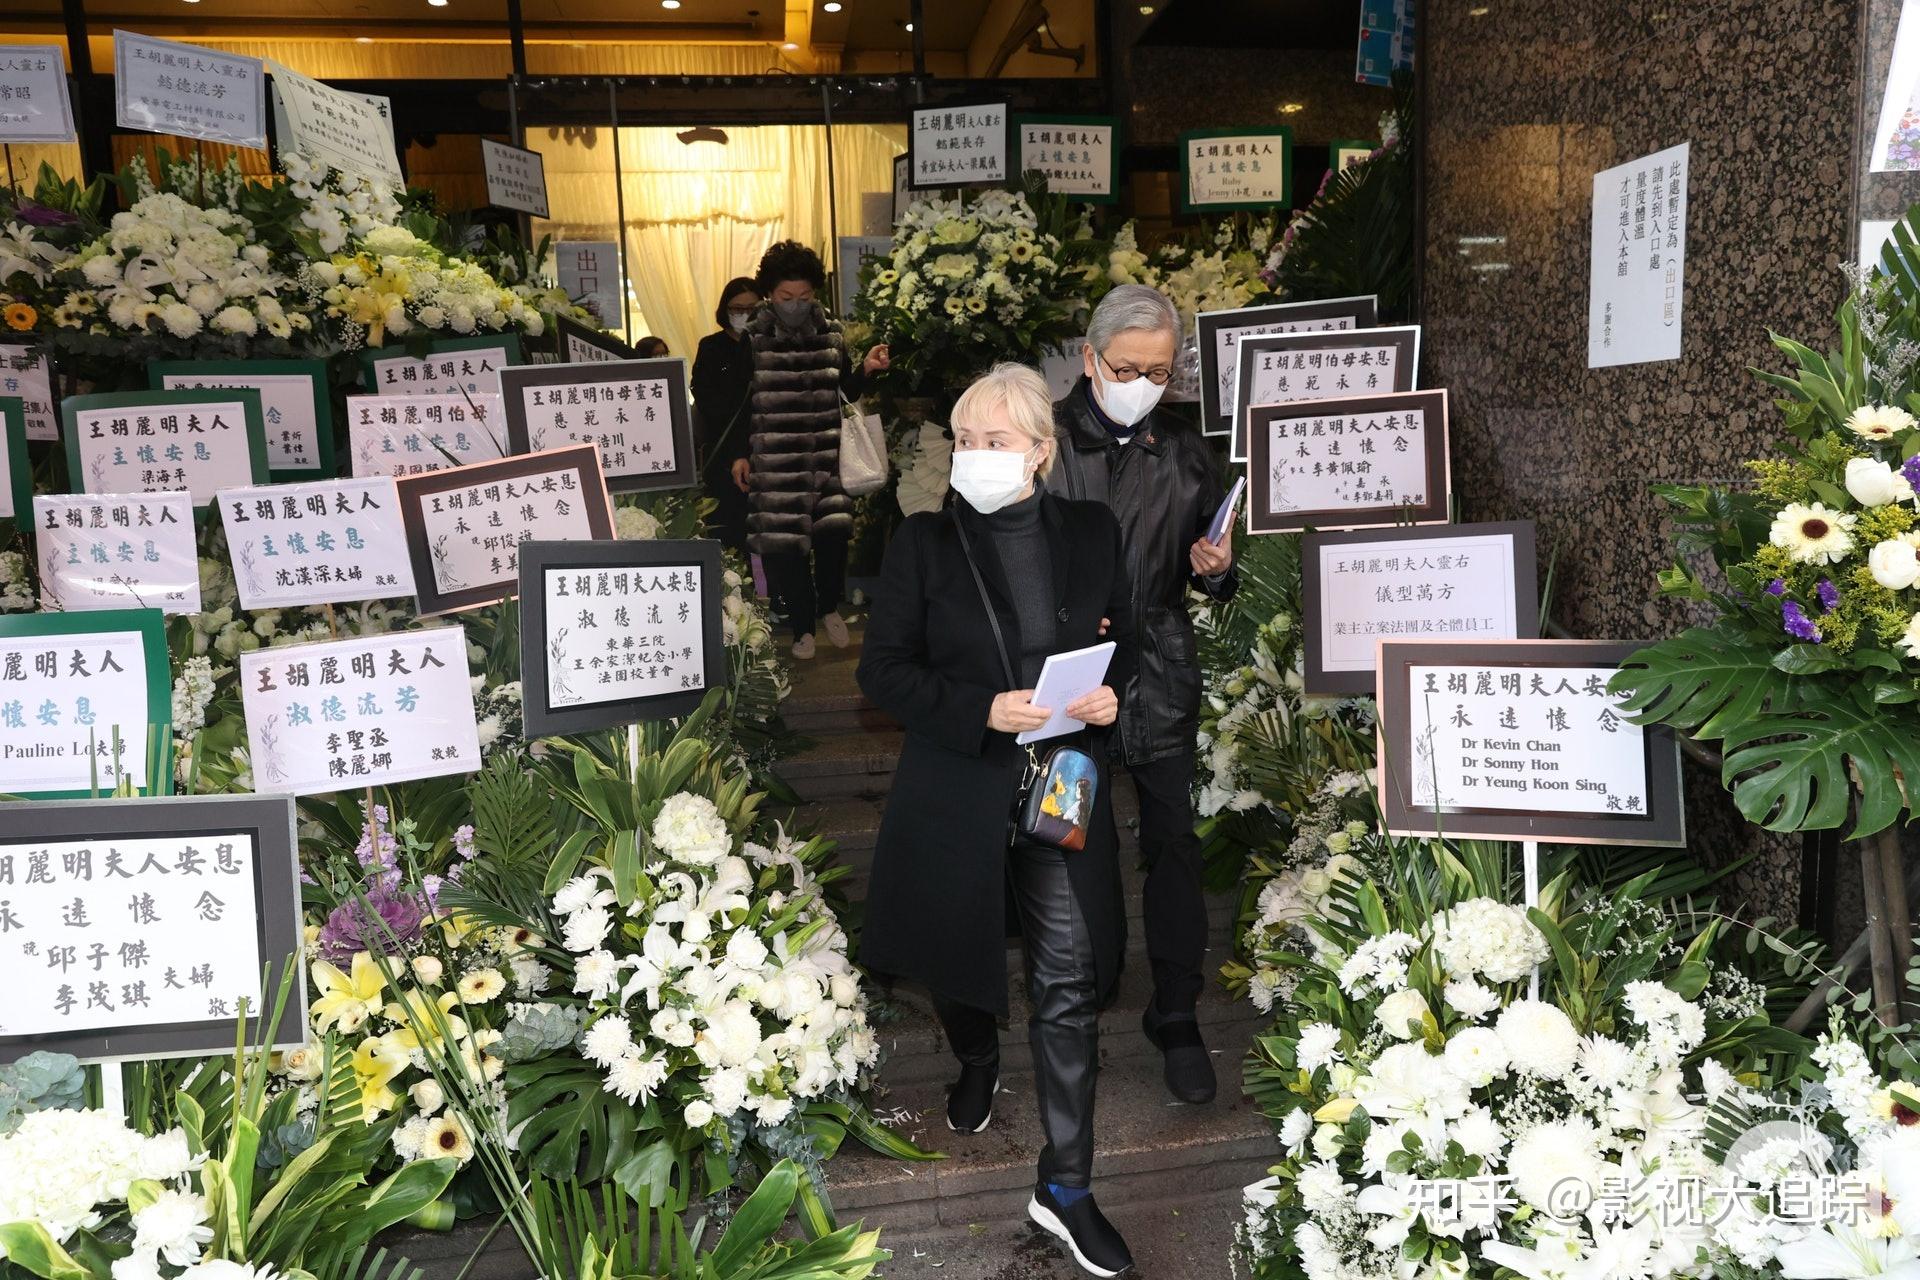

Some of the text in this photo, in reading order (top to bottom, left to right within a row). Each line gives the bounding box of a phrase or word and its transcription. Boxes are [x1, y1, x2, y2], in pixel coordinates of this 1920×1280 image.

[0, 59, 47, 71] 人靈右
[132, 48, 247, 80] 王胡麗明夫人靈右
[157, 74, 226, 99] 懿德流芳
[917, 112, 1001, 132] 王胡麗明夫人靈右
[936, 135, 986, 150] 懿範長存
[1027, 131, 1102, 146] 王胡麗明夫人
[1195, 143, 1273, 159] 王胡麗明夫人
[1039, 150, 1092, 165] 主懷安息
[1207, 160, 1262, 174] 主懷安息
[1208, 189, 1230, 199] Jenny
[1222, 177, 1242, 187] Ruby
[1634, 171, 1647, 241] 量度體溫
[1648, 165, 1664, 272] 請先到入口處
[1617, 176, 1631, 278] 才可進入本館
[385, 358, 495, 385] 王胡麗明夫人
[1262, 349, 1391, 371] 王胡麗明伯母安息
[532, 382, 664, 407] 王胡麗明伯母靈右
[1277, 372, 1379, 393] 慈範永存
[89, 413, 230, 440] 王胡麗明夫人
[265, 405, 282, 425] 念
[359, 404, 489, 426] 王胡麗明伯母
[554, 405, 656, 430] 慈範永存
[1277, 413, 1420, 439] 王胡麗明夫人安息
[112, 440, 212, 467] 主懷安息
[380, 431, 472, 454] 主懷安息
[1295, 435, 1409, 458] 永遠懷念
[141, 468, 187, 484] 梁海平
[431, 472, 577, 515] 王胡麗明夫人安息
[44, 504, 178, 530] 王胡麗明夫人
[231, 490, 381, 524] 王胡麗明夫人
[454, 498, 571, 535] 永遠懷念
[66, 539, 161, 565] 主懷安息
[261, 526, 366, 558] 主懷安息
[275, 564, 363, 588] 沈漢深夫婦
[1334, 553, 1471, 575] 王胡麗明夫人靈右
[556, 570, 698, 598] 王胡麗明夫人安息
[1375, 582, 1456, 604] 儀型萬方
[577, 601, 691, 630] 淑德流芳
[1334, 616, 1495, 637] 業主立案法團及全體員工
[606, 634, 666, 652] 東華三院
[2, 649, 125, 682] 麗明夫人
[256, 646, 446, 693] 王胡麗明夫人
[573, 646, 693, 671] 王余家潔紀念小學
[598, 664, 674, 685] 法團校董會
[1, 696, 97, 729] 懷安息
[286, 684, 420, 728] 淑德流芳
[1449, 703, 1621, 734] 永遠懷念
[4, 742, 65, 760] Pauline
[325, 727, 390, 754] 李聖丞
[1461, 737, 1562, 753] Dr Kevin Chan
[328, 752, 393, 778] 陳麗娜
[1461, 756, 1560, 773] Dr Sonny Hon
[1462, 774, 1608, 795] Dr Yeung Koon Sing
[0, 890, 226, 933] 永遠懷念
[23, 938, 151, 975] 晚 邱子傑
[163, 963, 215, 989] 夫婦
[53, 979, 152, 1017] 李茂琪
